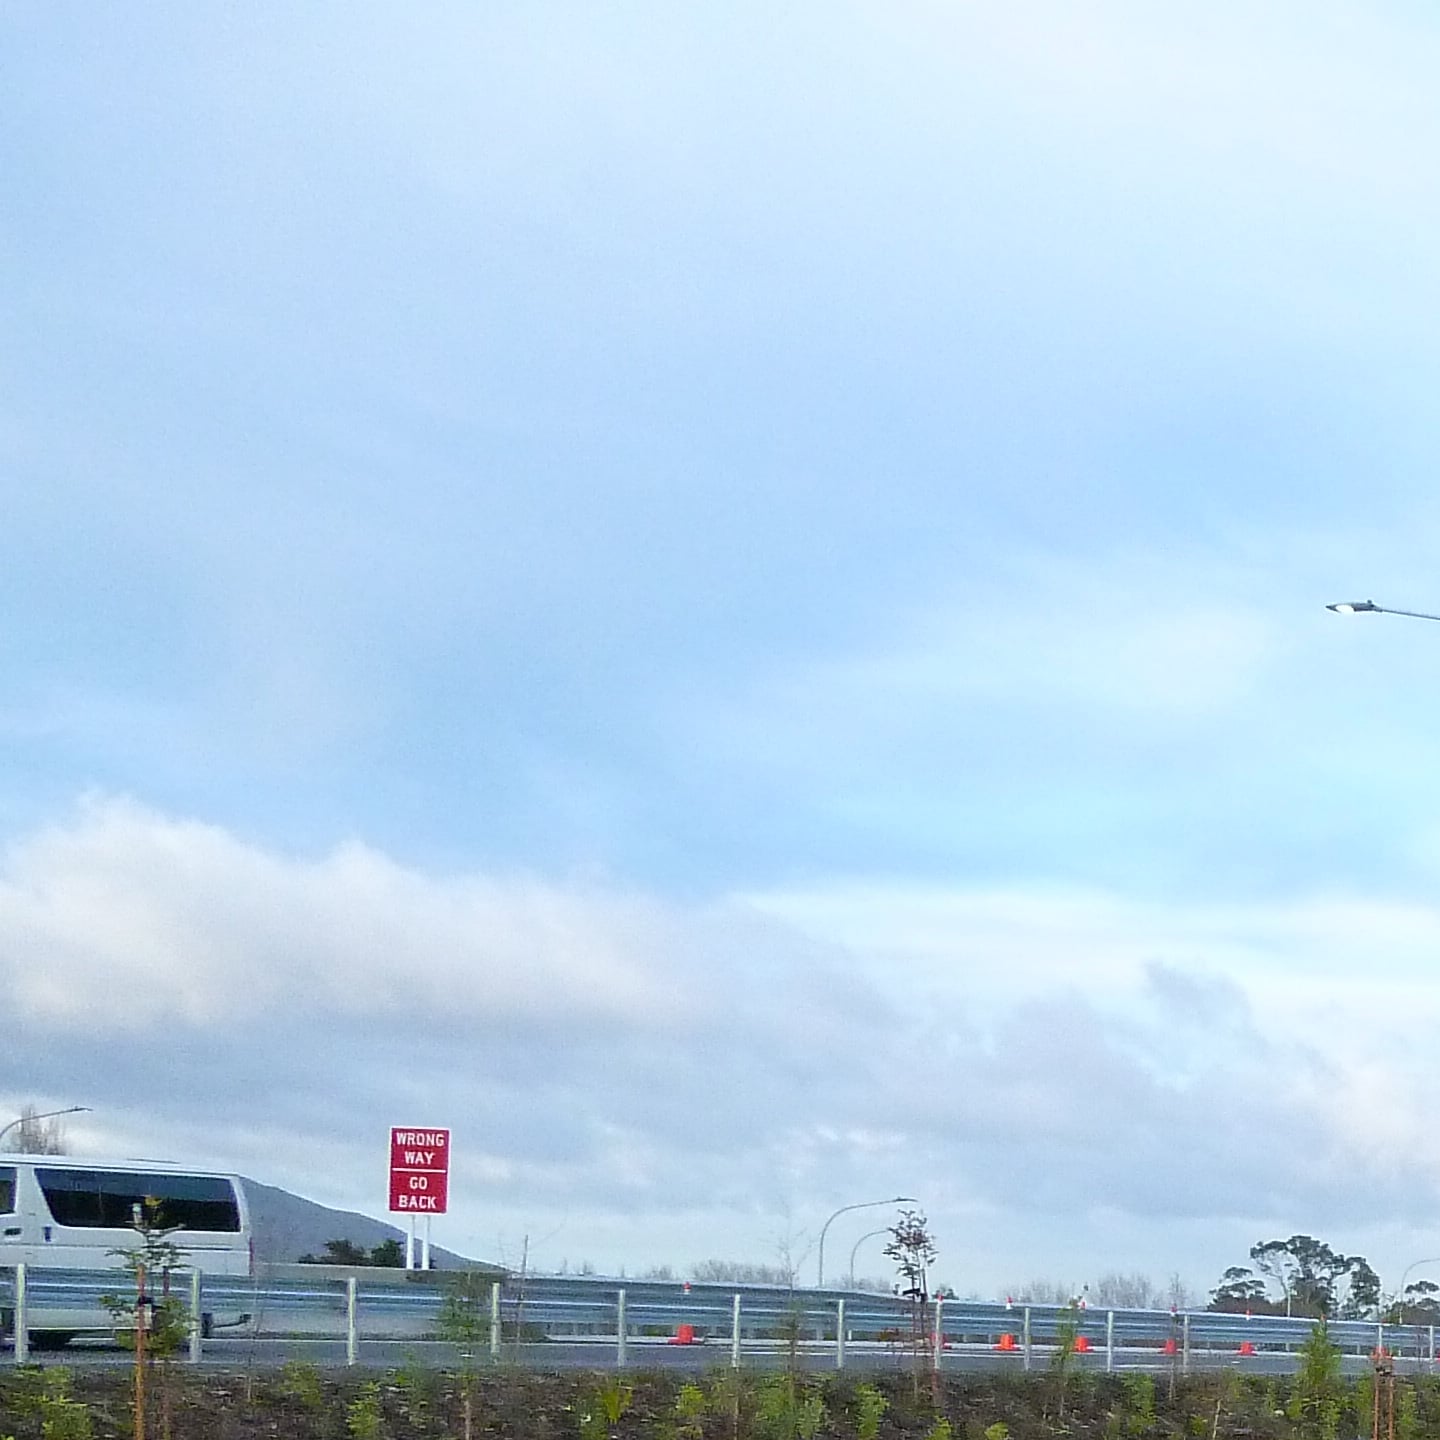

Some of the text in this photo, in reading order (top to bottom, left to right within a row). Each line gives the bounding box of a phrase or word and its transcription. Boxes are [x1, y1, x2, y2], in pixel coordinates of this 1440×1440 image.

[396, 1132, 445, 1147] WRONG
[404, 1151, 435, 1165] WAY
[409, 1176, 428, 1190] GO
[398, 1194, 437, 1209] BACK
